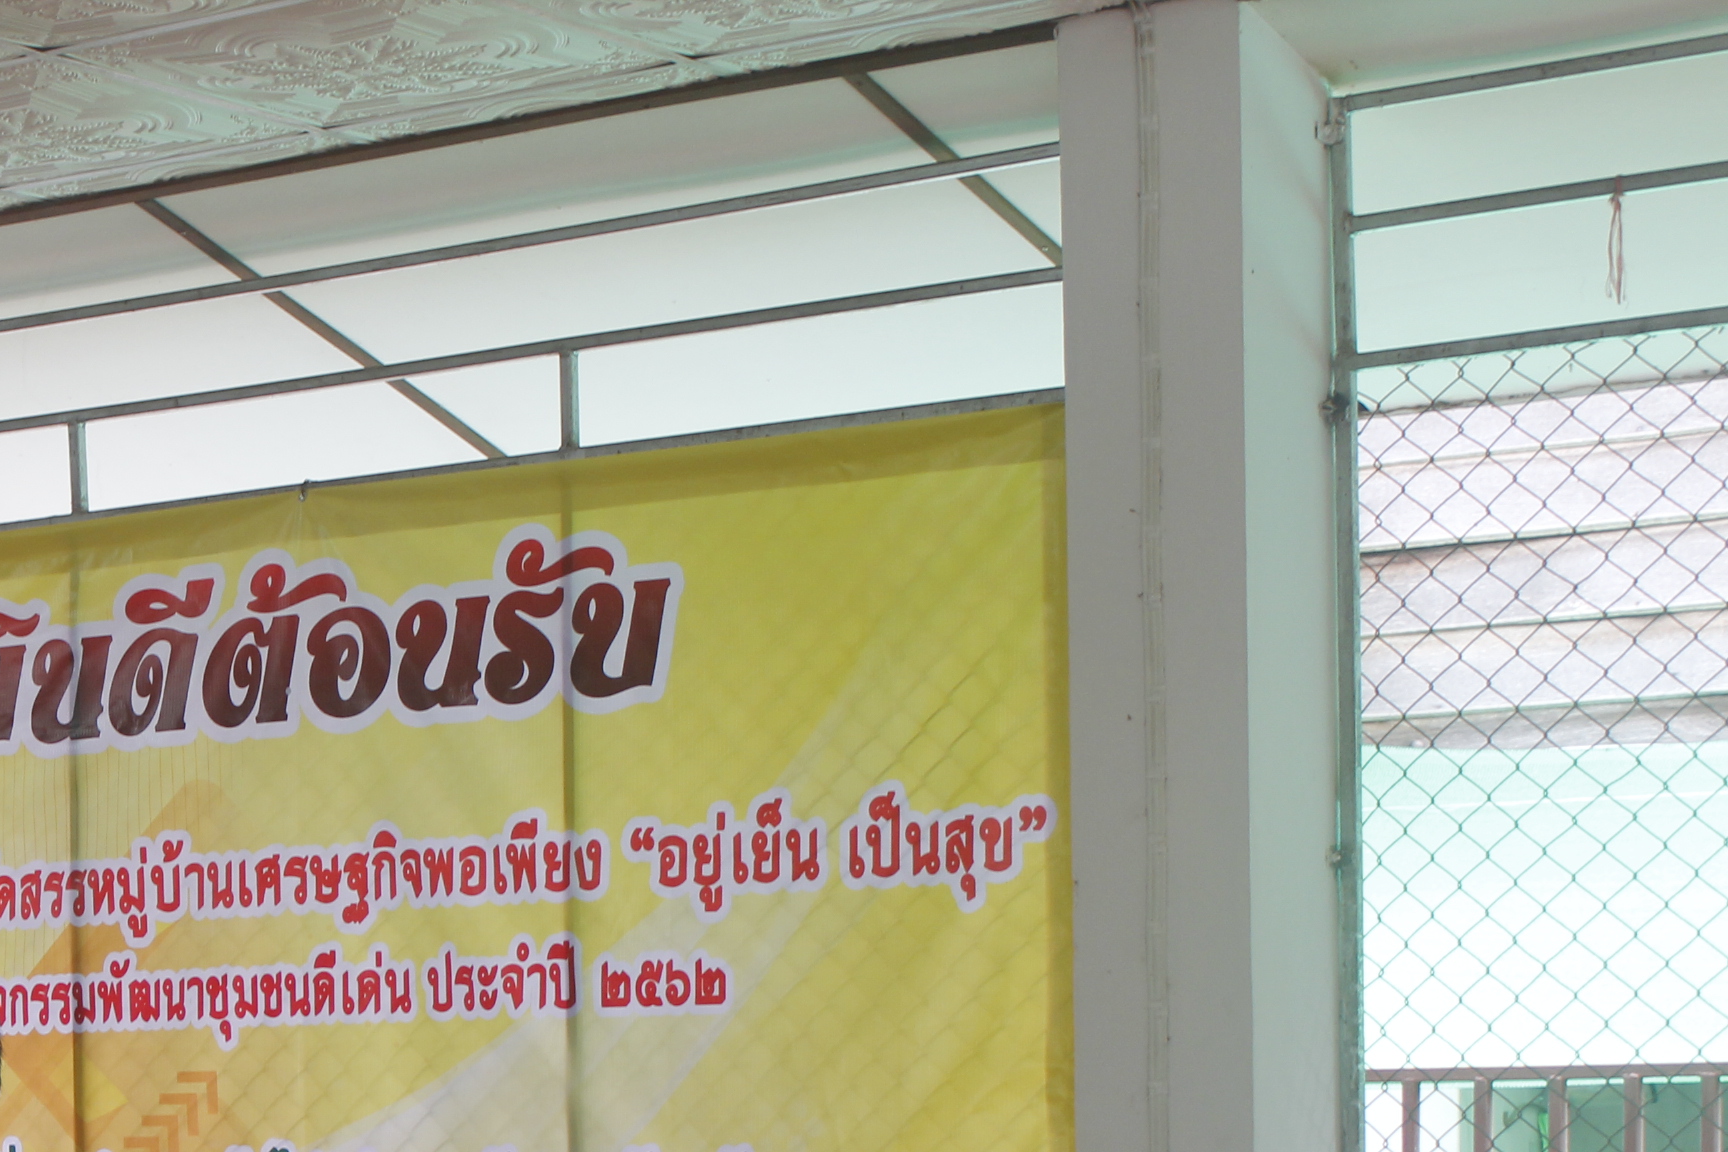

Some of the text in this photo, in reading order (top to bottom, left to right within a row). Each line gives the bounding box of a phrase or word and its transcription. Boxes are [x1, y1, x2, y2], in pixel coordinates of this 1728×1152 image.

[630, 798, 820, 912] “อยู่เย็น
[849, 791, 1047, 901] เป็นสุข”
[427, 941, 576, 1013] ประจำปี
[601, 957, 727, 1008] ๒๕๖๒
